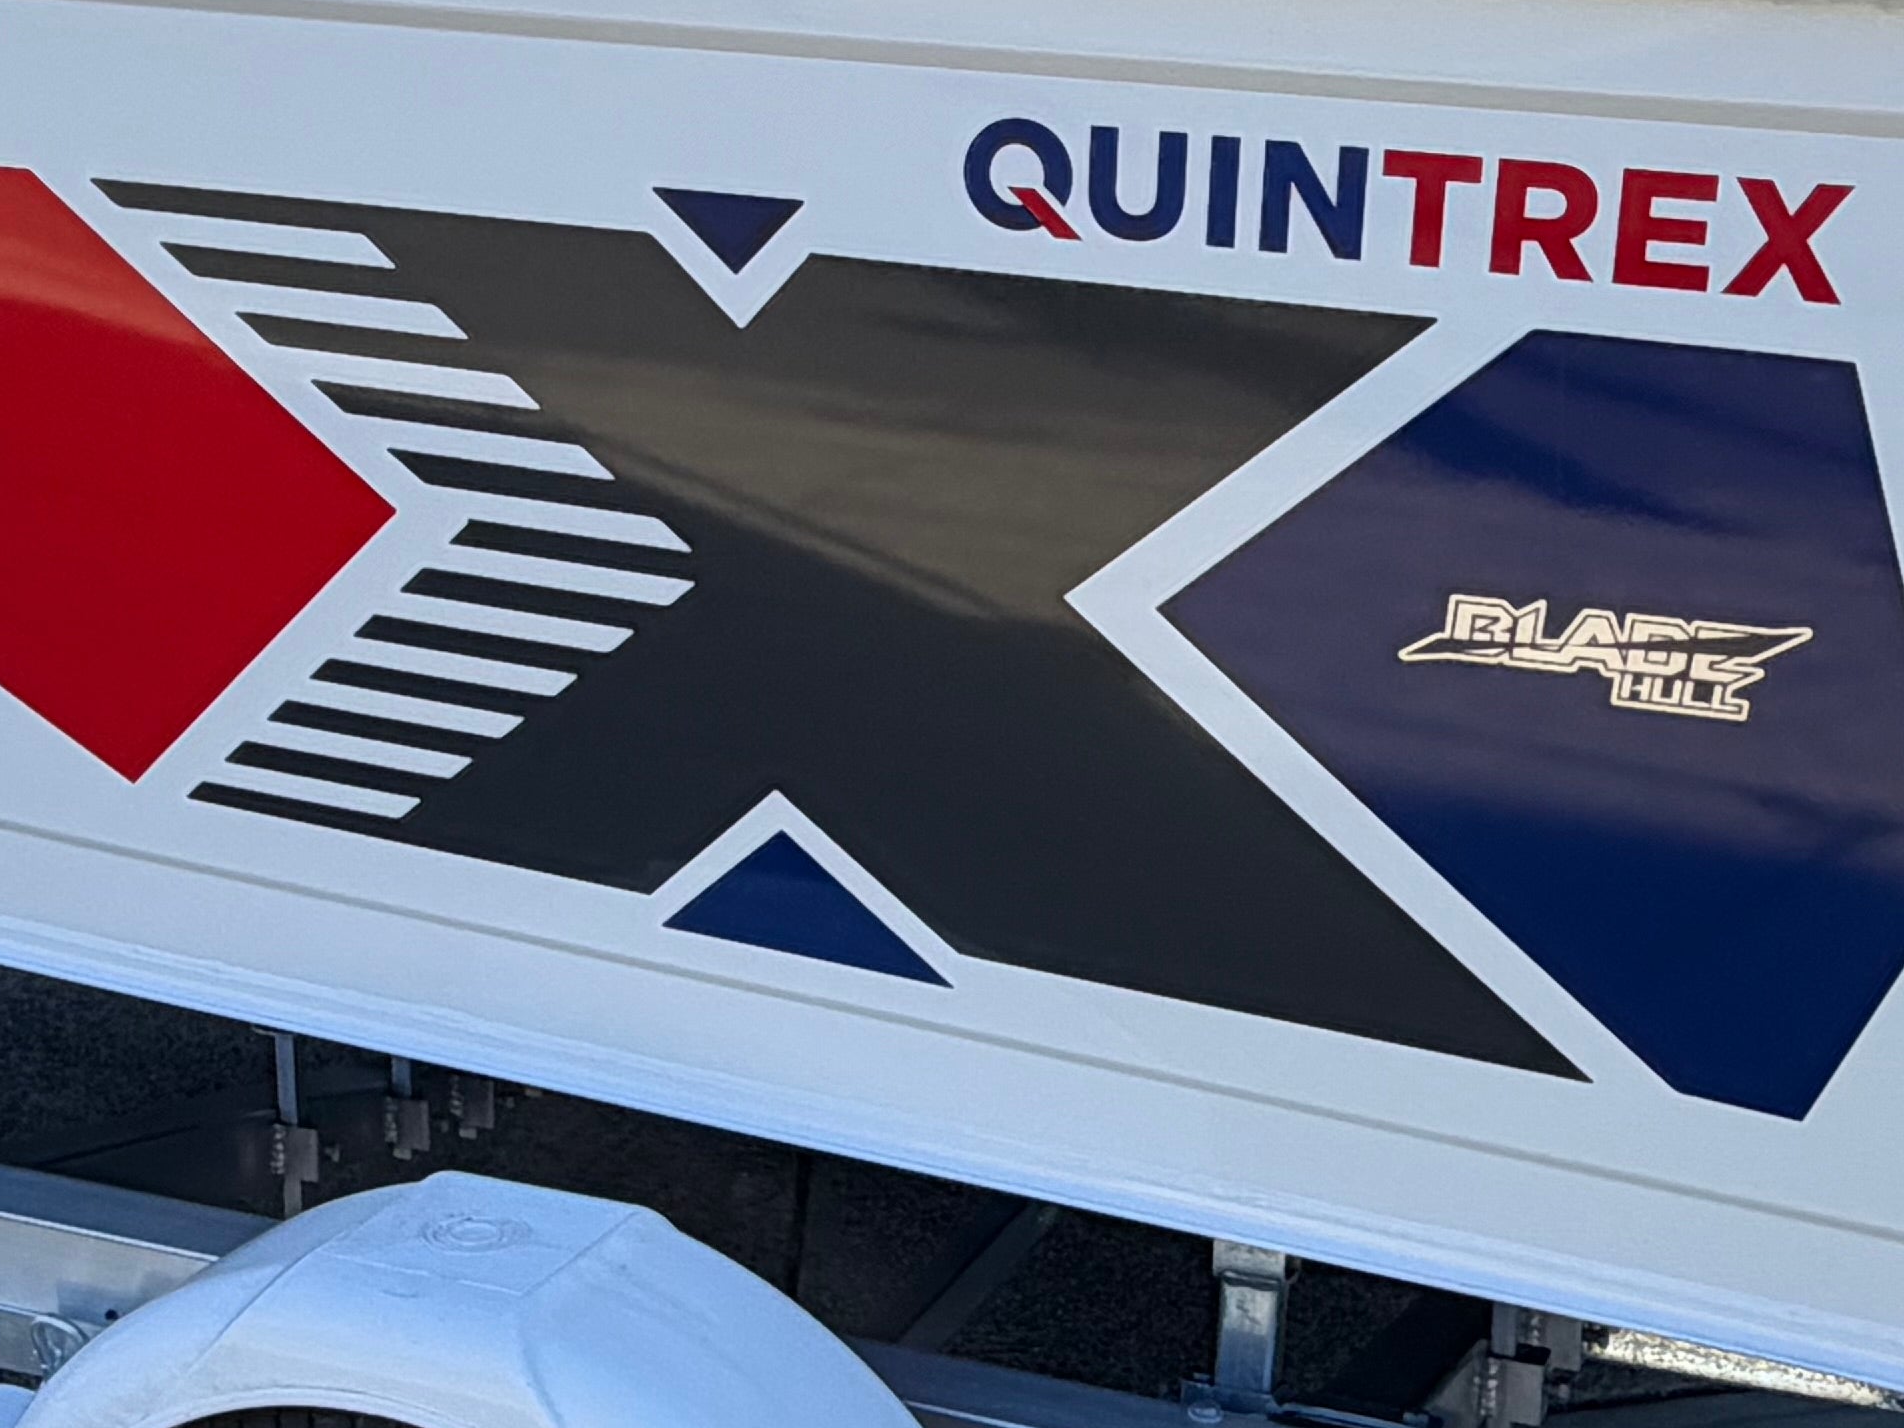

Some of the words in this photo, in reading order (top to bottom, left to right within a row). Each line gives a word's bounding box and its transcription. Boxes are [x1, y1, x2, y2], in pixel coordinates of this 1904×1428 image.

[963, 117, 1856, 306] QUINTREX
[1399, 594, 1813, 682] BLADE
[1618, 676, 1746, 714] HULL
